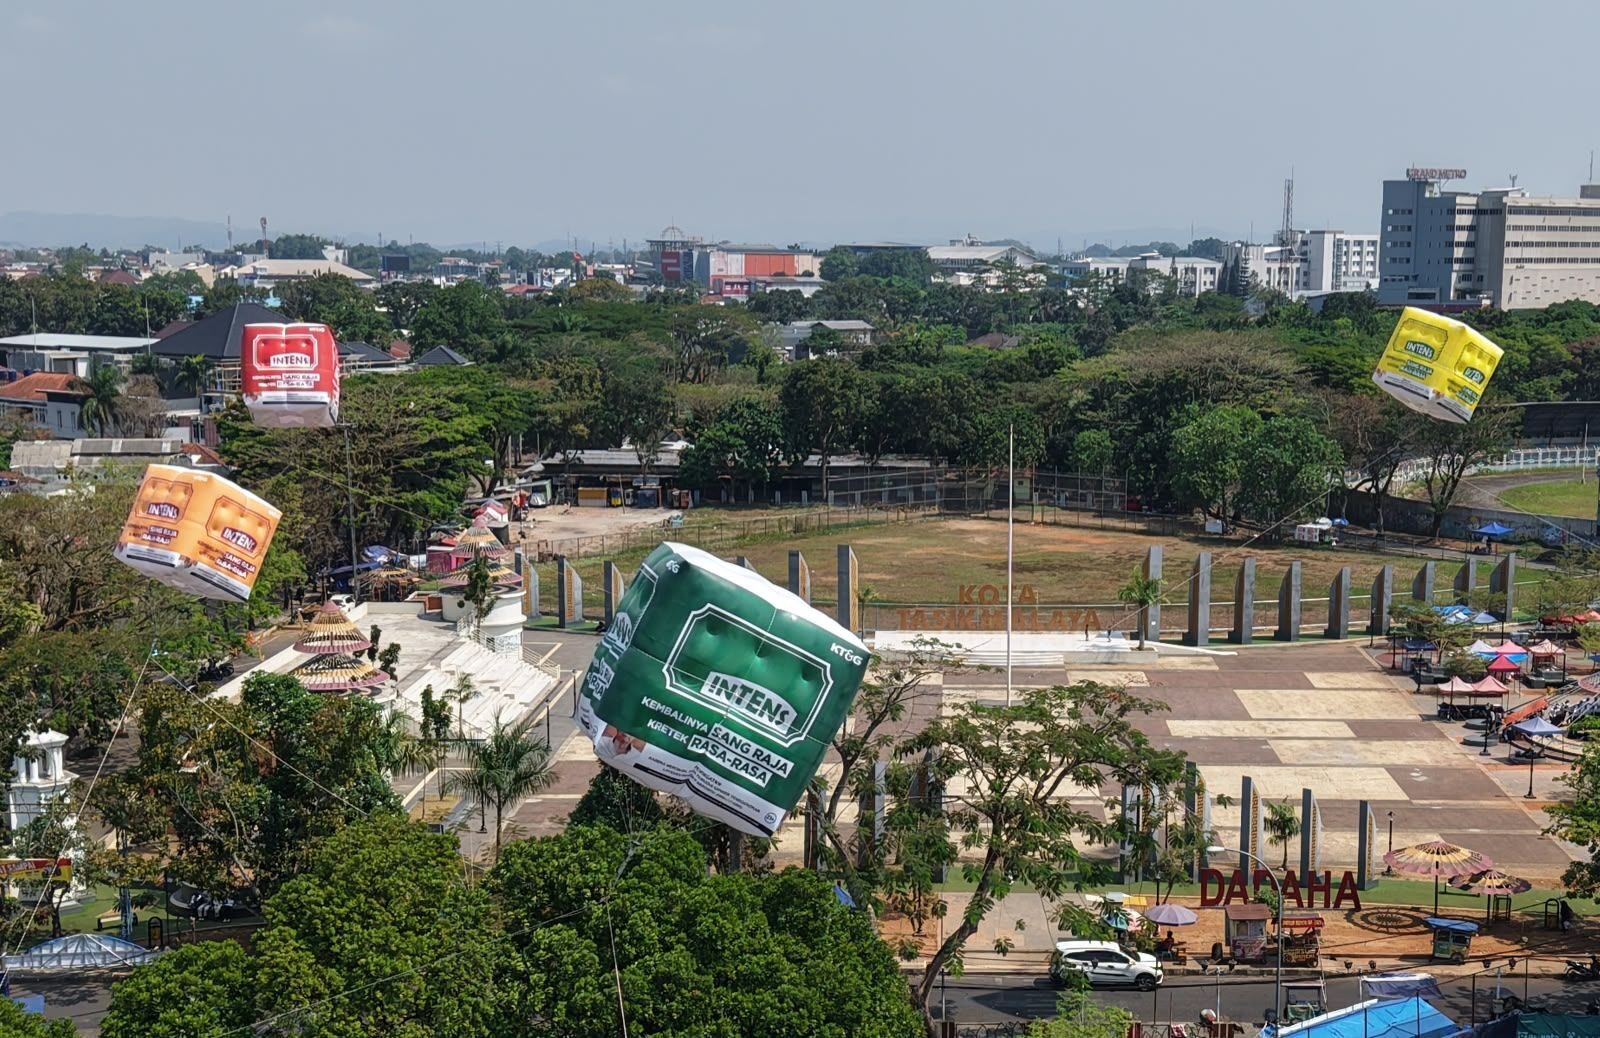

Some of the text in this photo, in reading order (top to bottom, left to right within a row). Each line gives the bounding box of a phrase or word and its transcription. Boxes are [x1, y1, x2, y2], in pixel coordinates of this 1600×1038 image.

[830, 642, 863, 666] KT&G
[708, 675, 790, 727] INTENS
[641, 696, 788, 775] KEMBALINYA SANG RAJA
[647, 718, 689, 744] KRETEK
[690, 739, 767, 784] RASA-RASA
